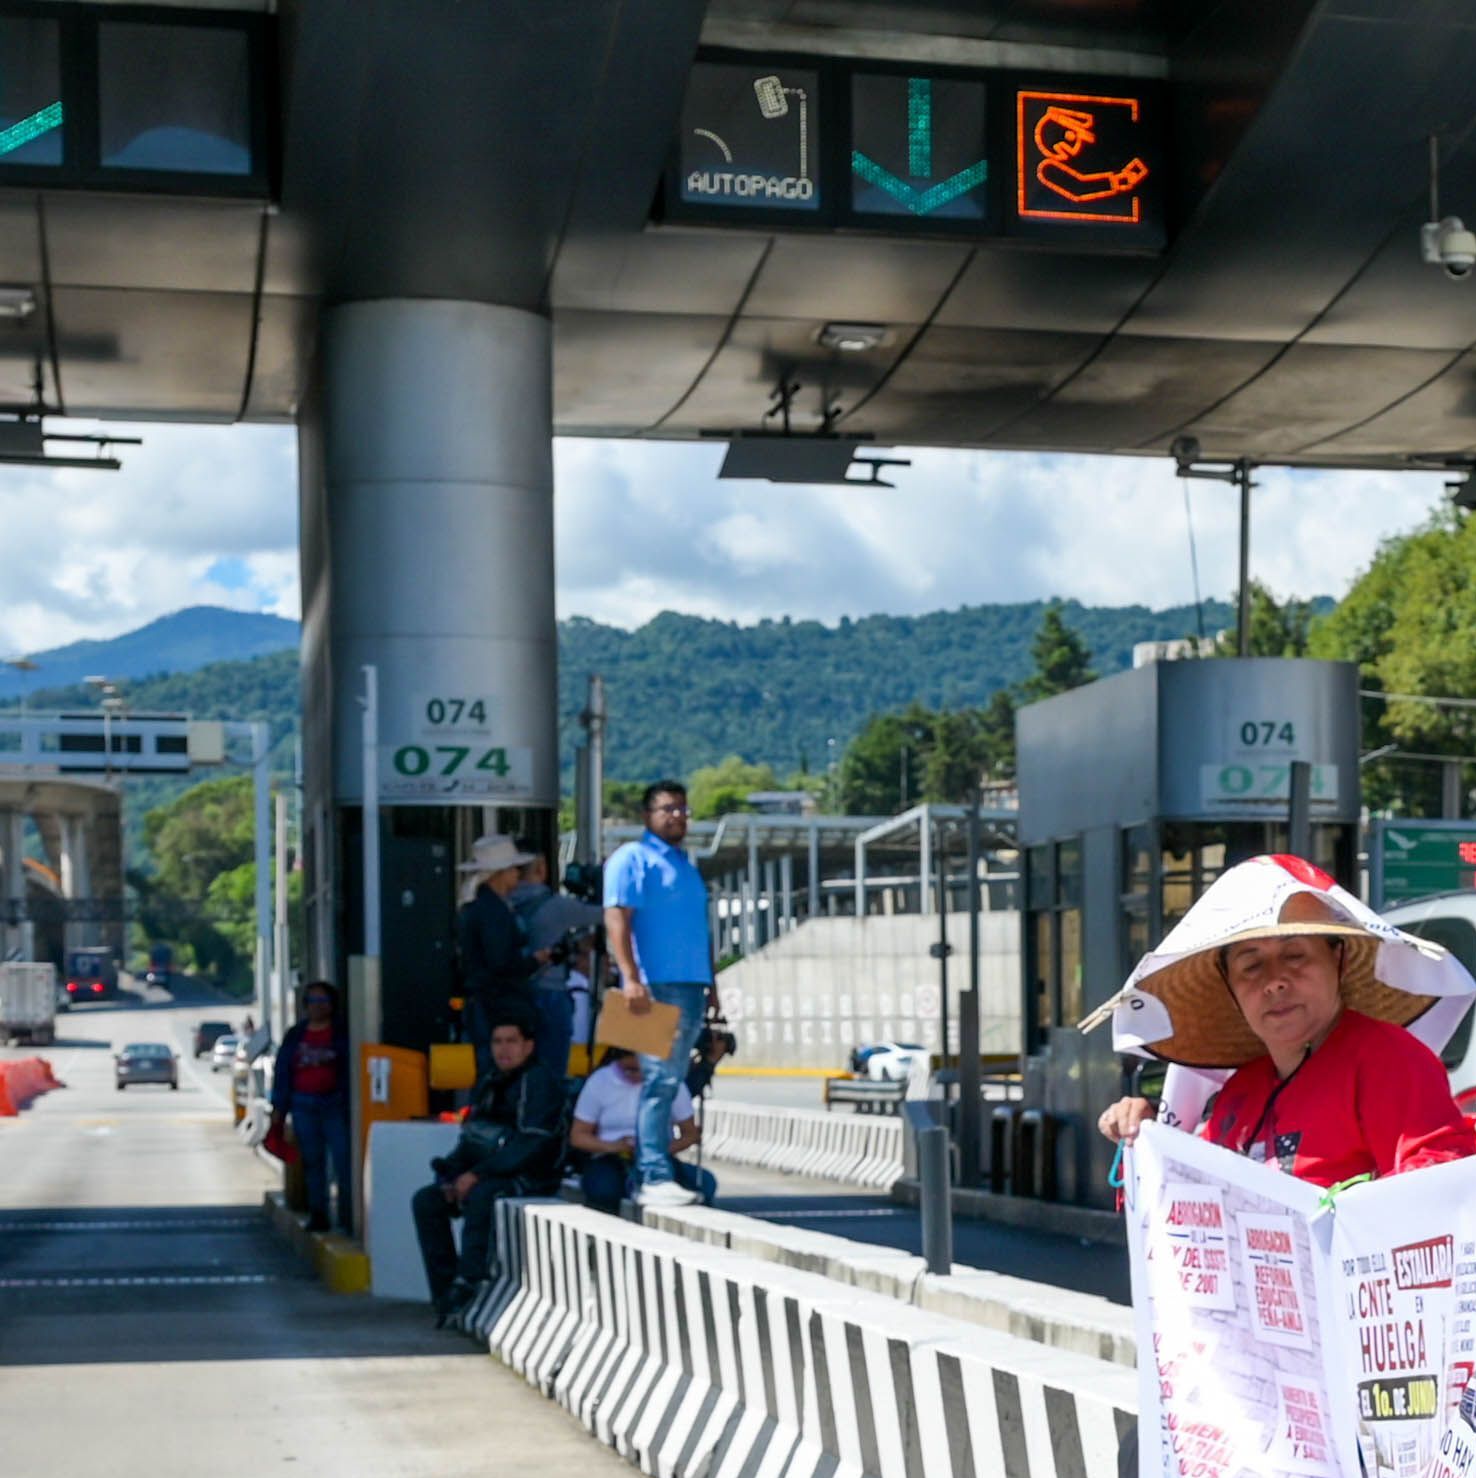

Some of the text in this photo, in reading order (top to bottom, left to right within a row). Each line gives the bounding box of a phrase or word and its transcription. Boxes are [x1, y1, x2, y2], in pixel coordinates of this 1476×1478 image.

[687, 171, 813, 199] AUTOPAGO
[427, 698, 486, 725] 074
[1240, 722, 1295, 745] 074
[394, 746, 510, 777] 074
[1359, 1278, 1393, 1319] CNTE
[1360, 1319, 1427, 1373] HUELGA
